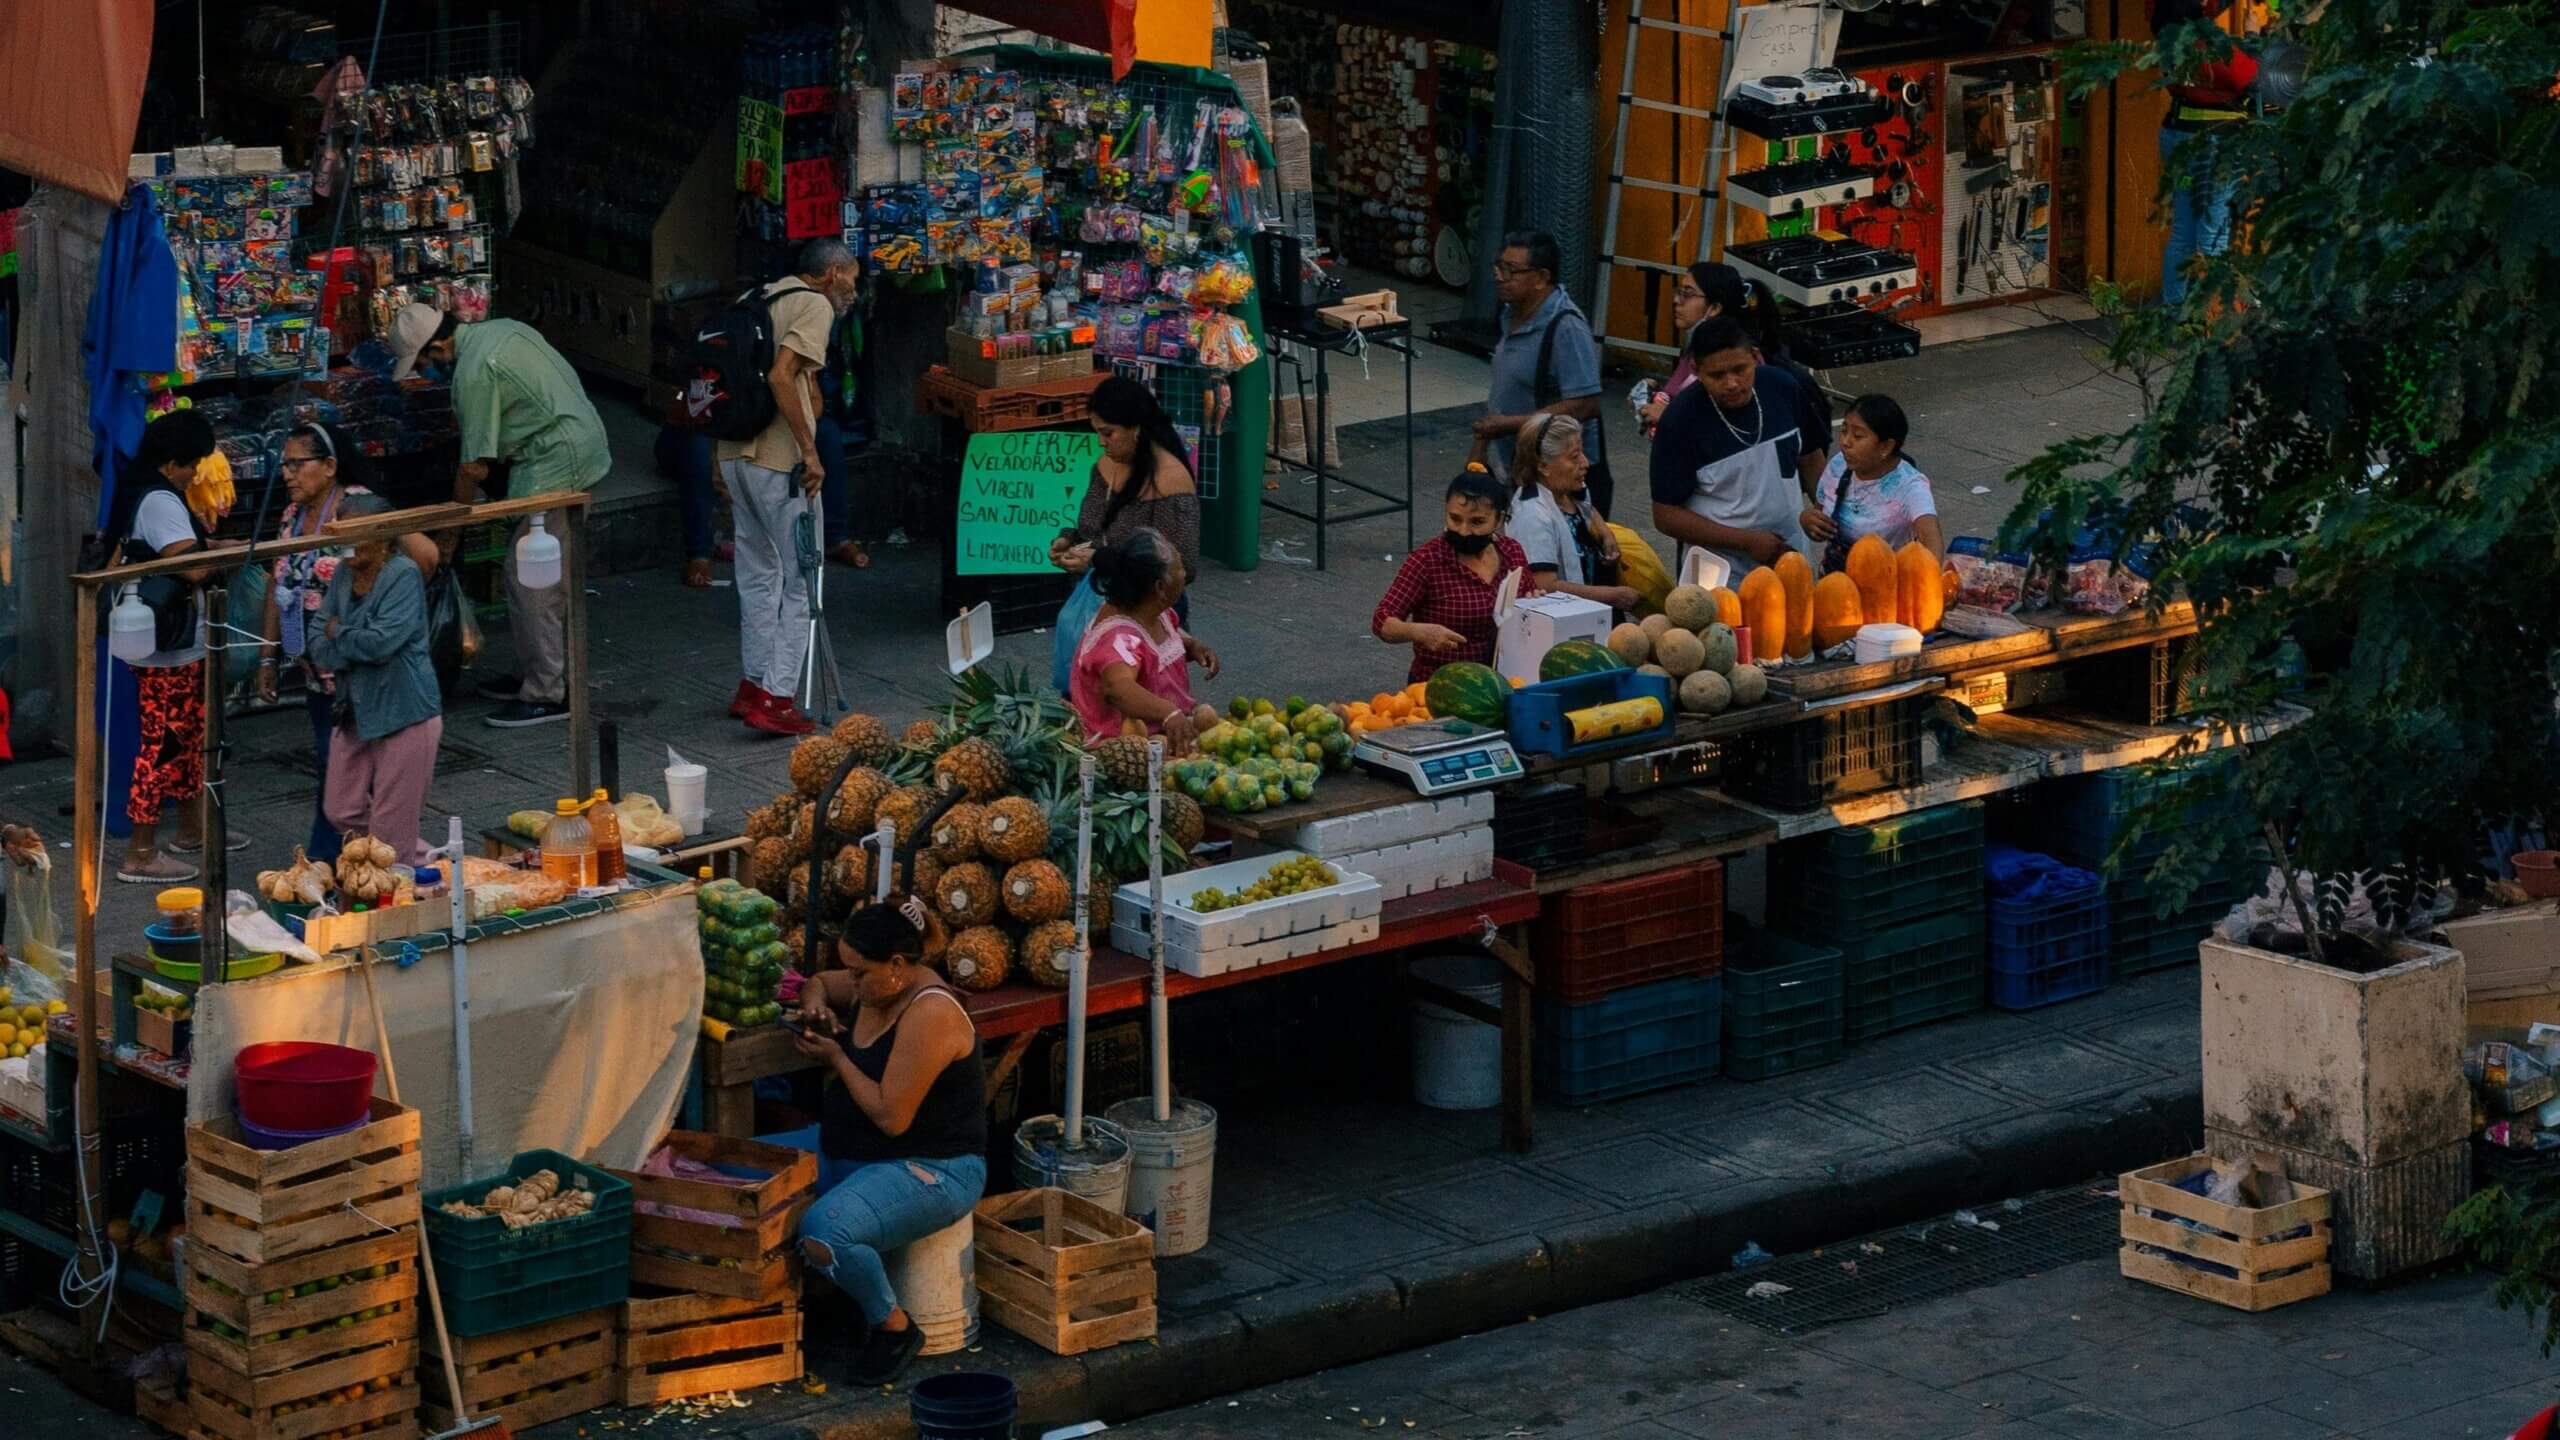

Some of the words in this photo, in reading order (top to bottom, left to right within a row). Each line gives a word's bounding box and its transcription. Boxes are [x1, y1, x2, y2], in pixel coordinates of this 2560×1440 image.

[1001, 433, 1093, 457] OFERTA
[970, 452, 1075, 473] VELADORAS:
[976, 477, 1034, 499] VIRGEN
[960, 502, 998, 523] SAN
[1003, 504, 1060, 527] JUDAS
[967, 538, 1044, 565] LIMONERO
